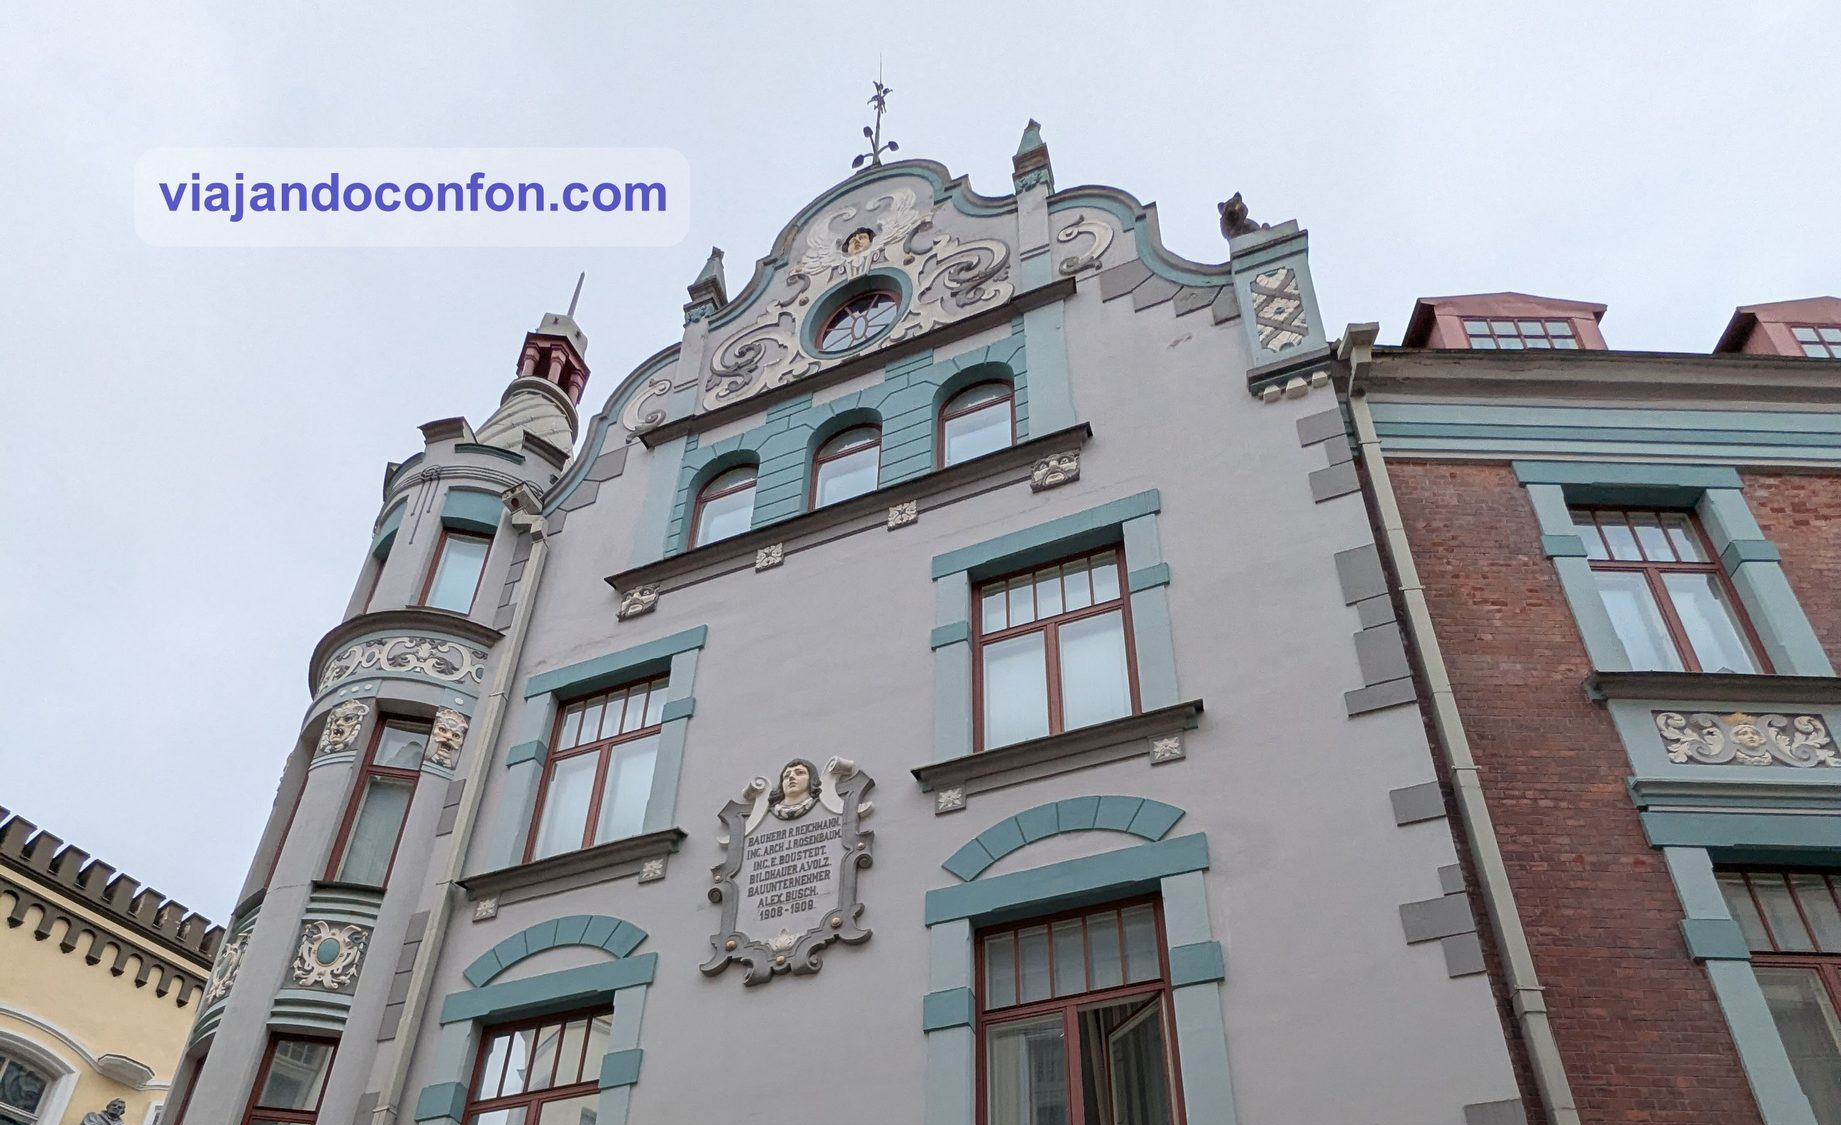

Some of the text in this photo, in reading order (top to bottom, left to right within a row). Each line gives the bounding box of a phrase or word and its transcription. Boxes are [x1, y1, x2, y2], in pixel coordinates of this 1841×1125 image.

[748, 829, 787, 847] BAUHERR
[747, 869, 831, 898] BAUUNTERNEHMER
[749, 864, 798, 884] BILDHAUER
